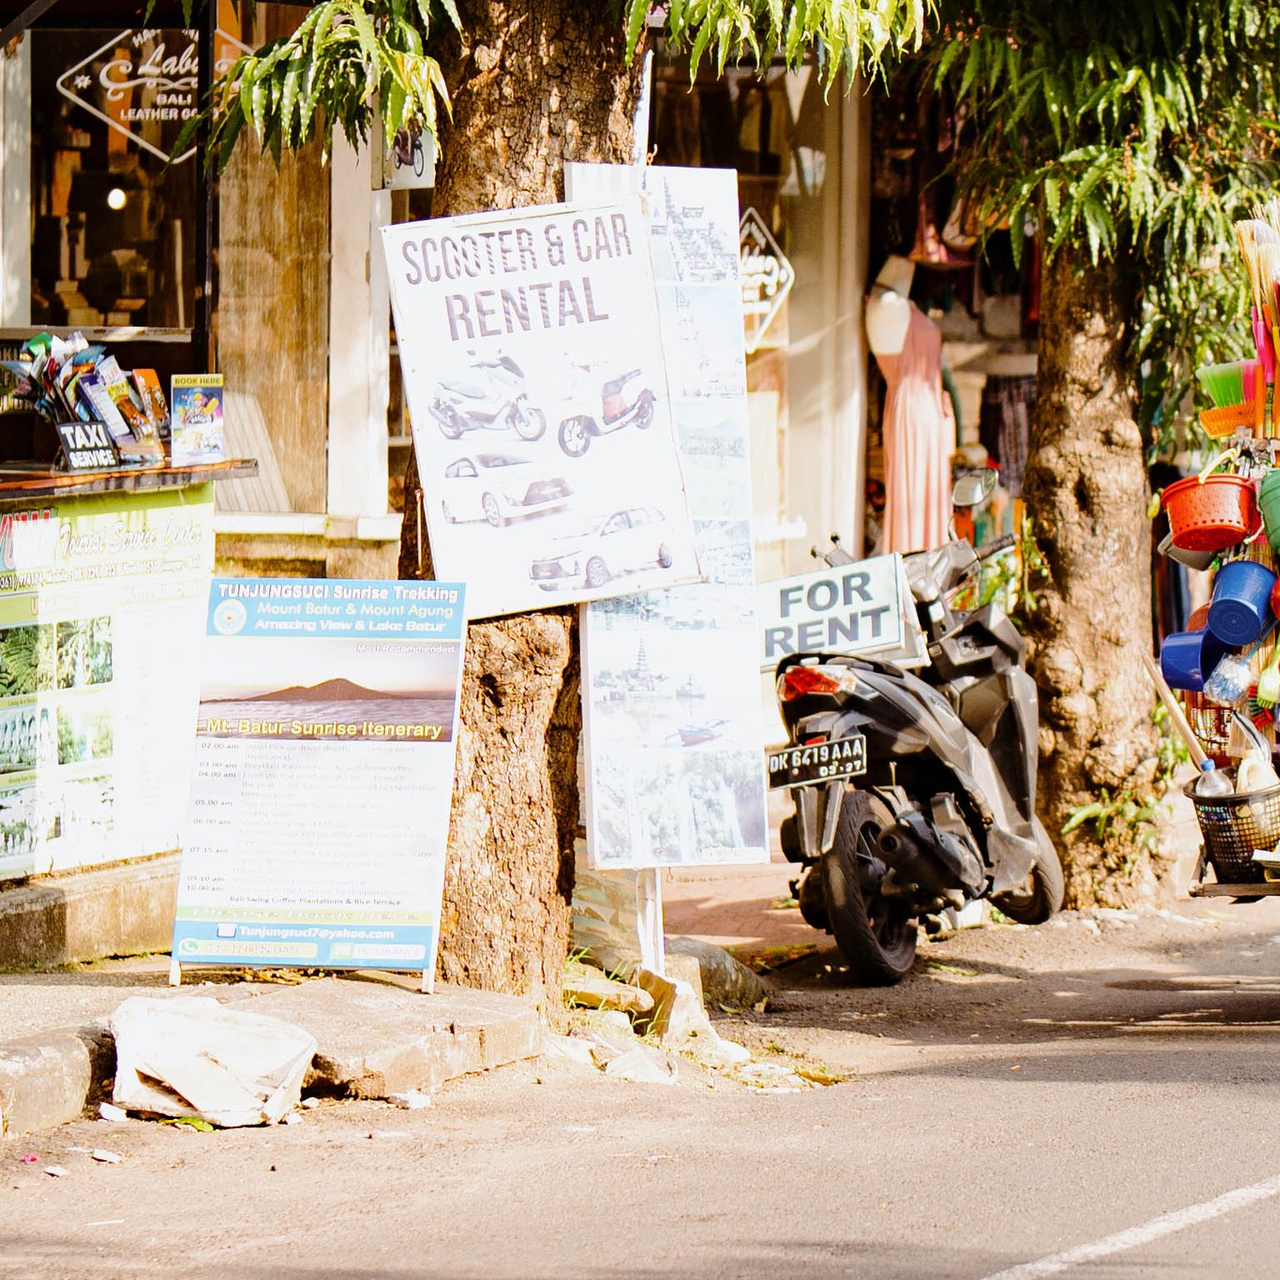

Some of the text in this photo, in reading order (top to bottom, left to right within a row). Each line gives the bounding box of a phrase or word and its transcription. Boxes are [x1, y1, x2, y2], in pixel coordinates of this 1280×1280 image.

[156, 94, 193, 106] BALI
[120, 107, 179, 121] LEATHER
[402, 213, 633, 286] SCOOTER & CAR
[444, 276, 610, 342] RENTAL
[174, 376, 221, 385] BOOK HERE
[60, 423, 110, 450] TAXI
[68, 449, 116, 468] SERVICE
[218, 583, 330, 599] TUNJUNGSUCI
[333, 585, 390, 600] Sunrise
[393, 585, 459, 604] Trekking
[779, 571, 874, 619] FOR
[257, 602, 454, 620] Mount Batur & Mount Agung
[254, 619, 447, 633] Amazing View & Lake Batur
[764, 604, 891, 658] RENT
[382, 645, 455, 655] Recommended
[206, 719, 443, 740] Mt. Batur Sunrise Itenerary
[769, 738, 863, 774] DK 6419 AAA
